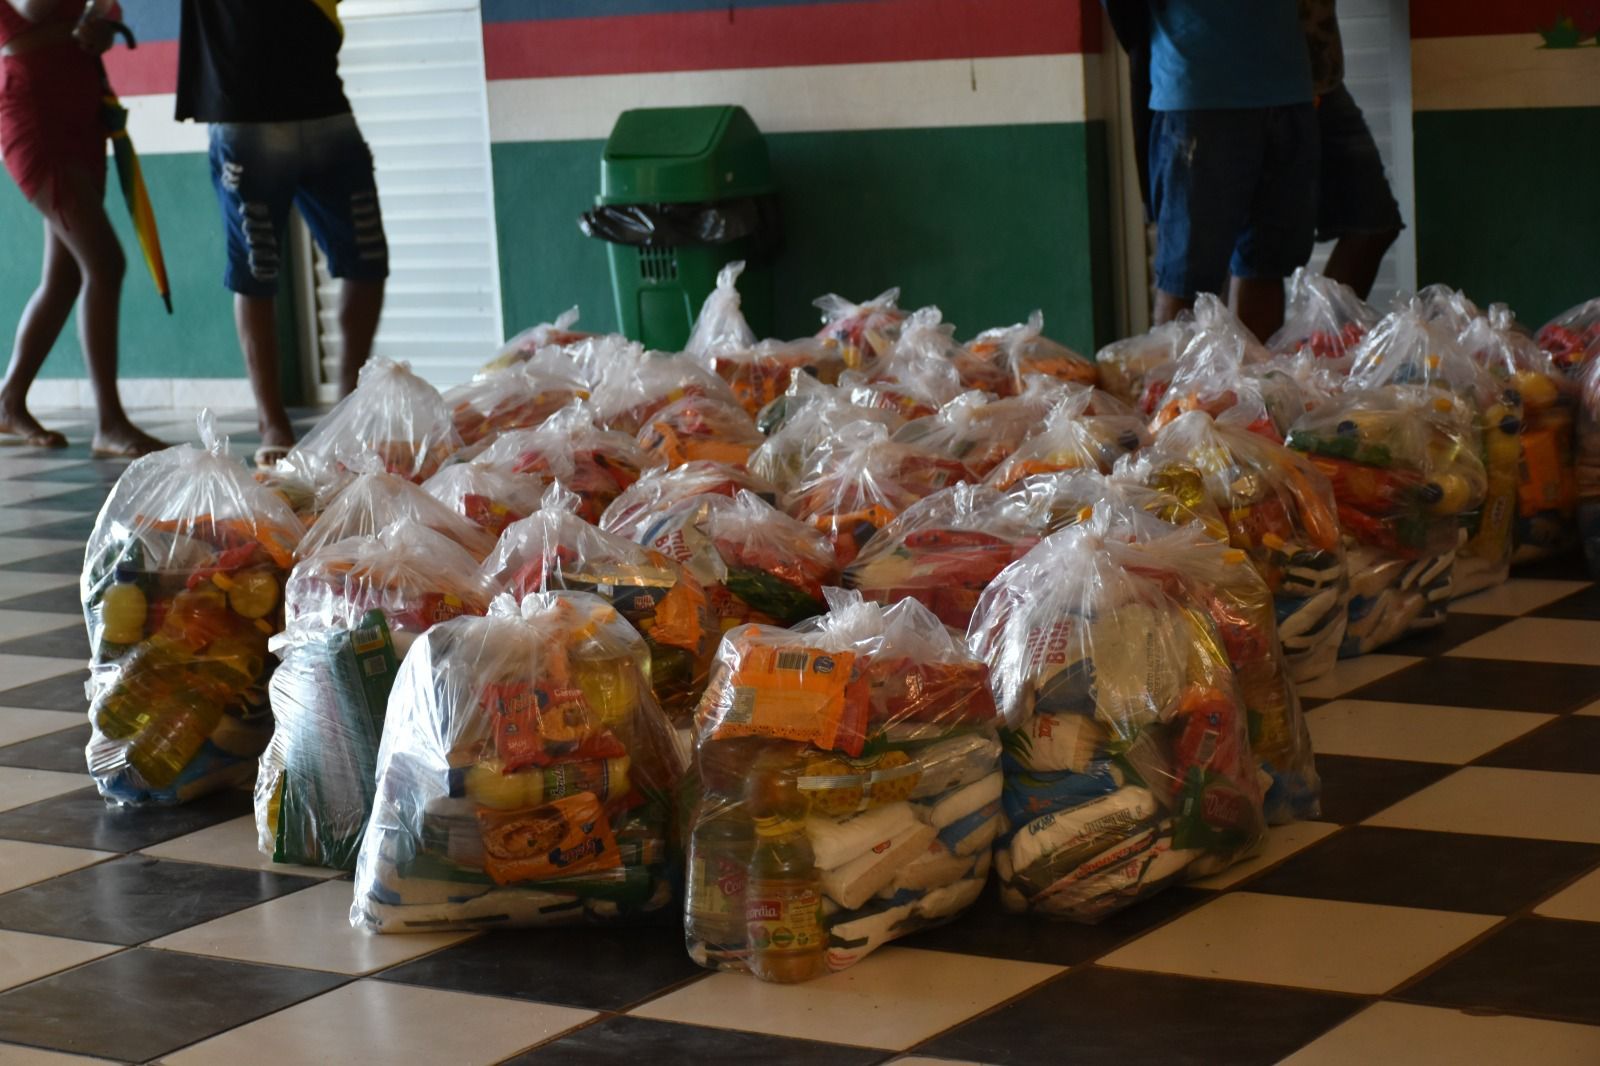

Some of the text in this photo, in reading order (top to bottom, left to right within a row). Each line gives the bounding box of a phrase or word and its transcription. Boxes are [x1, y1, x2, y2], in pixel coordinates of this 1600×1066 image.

[655, 534, 672, 556] BO
[671, 529, 693, 565] milk
[1044, 620, 1071, 665] BOM
